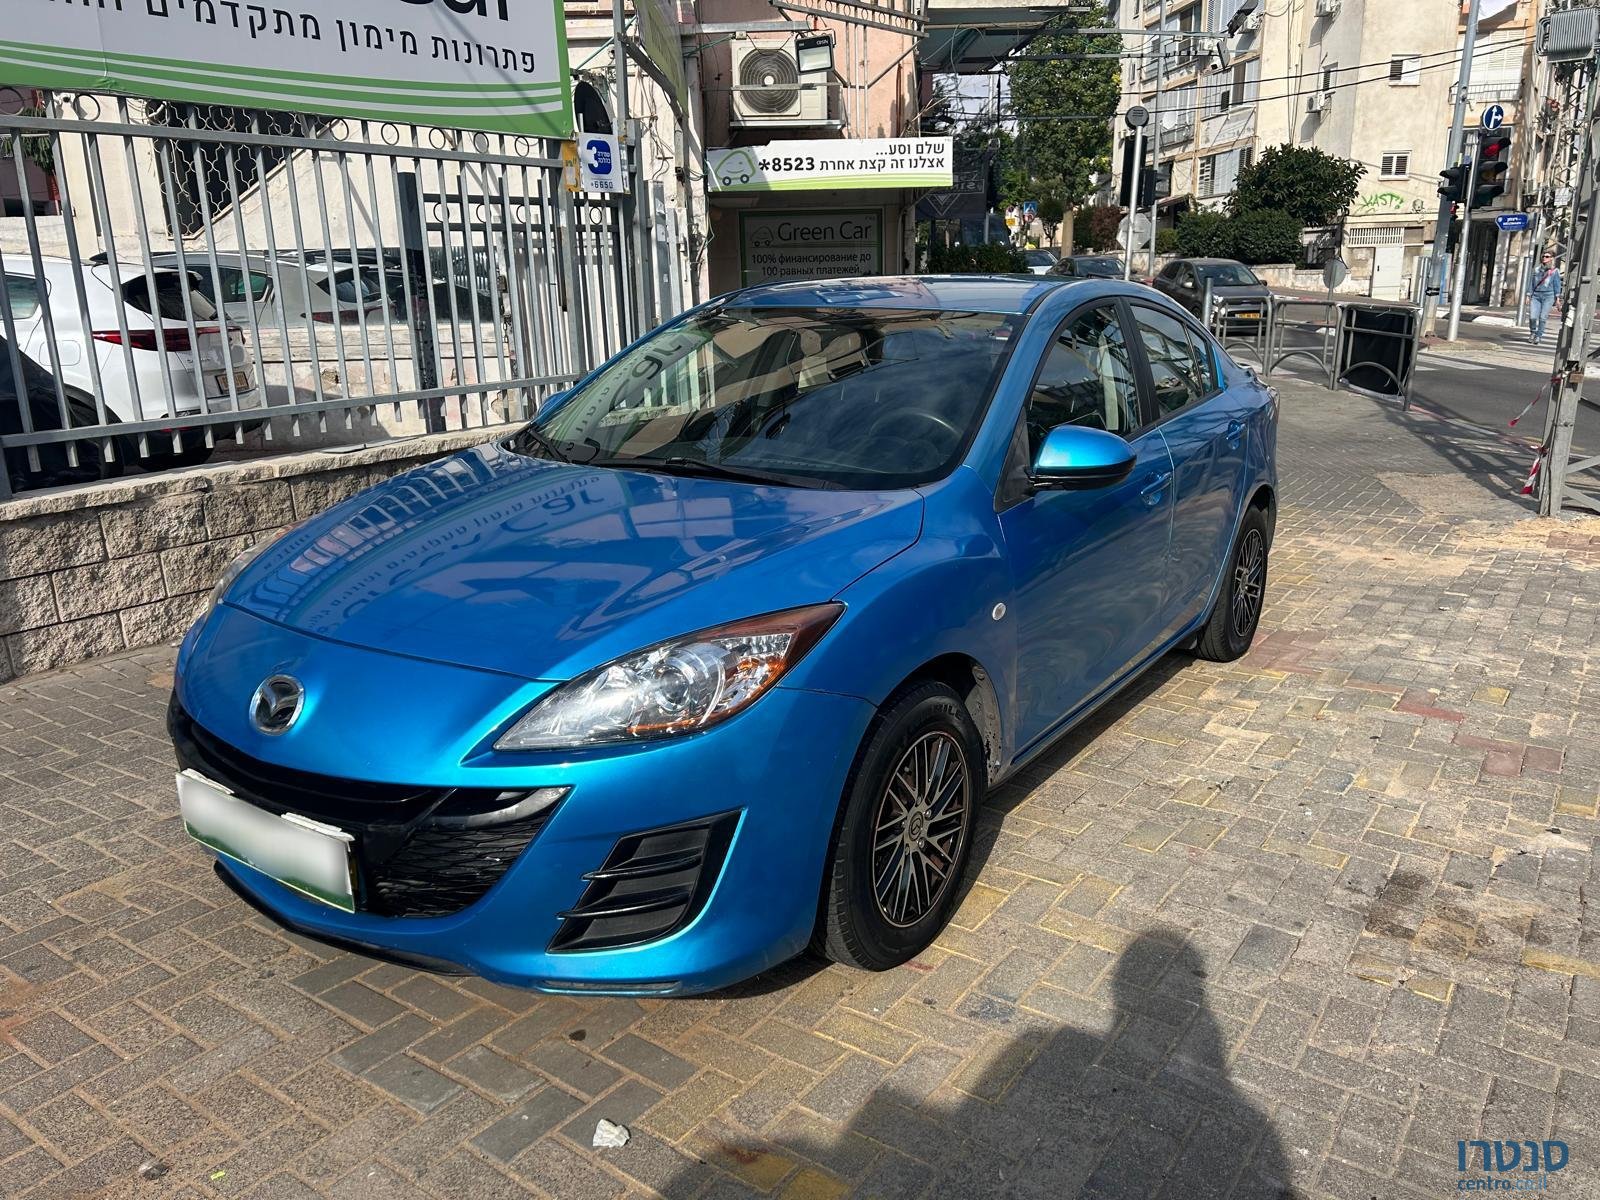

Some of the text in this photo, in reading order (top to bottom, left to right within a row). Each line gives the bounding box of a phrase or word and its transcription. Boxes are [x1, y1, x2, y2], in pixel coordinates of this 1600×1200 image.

[335, 20, 418, 55] מימון
[431, 36, 535, 73] פתרונות
[876, 141, 945, 155] שלם וסע...
[819, 159, 855, 171] אחרת
[859, 158, 886, 173] קצת
[890, 158, 905, 169] זה
[909, 156, 945, 169] אצלנו
[777, 220, 872, 241] Green Car
[752, 253, 872, 265] 100% финансирование до
[762, 266, 778, 276] 100
[779, 267, 814, 278] равных
